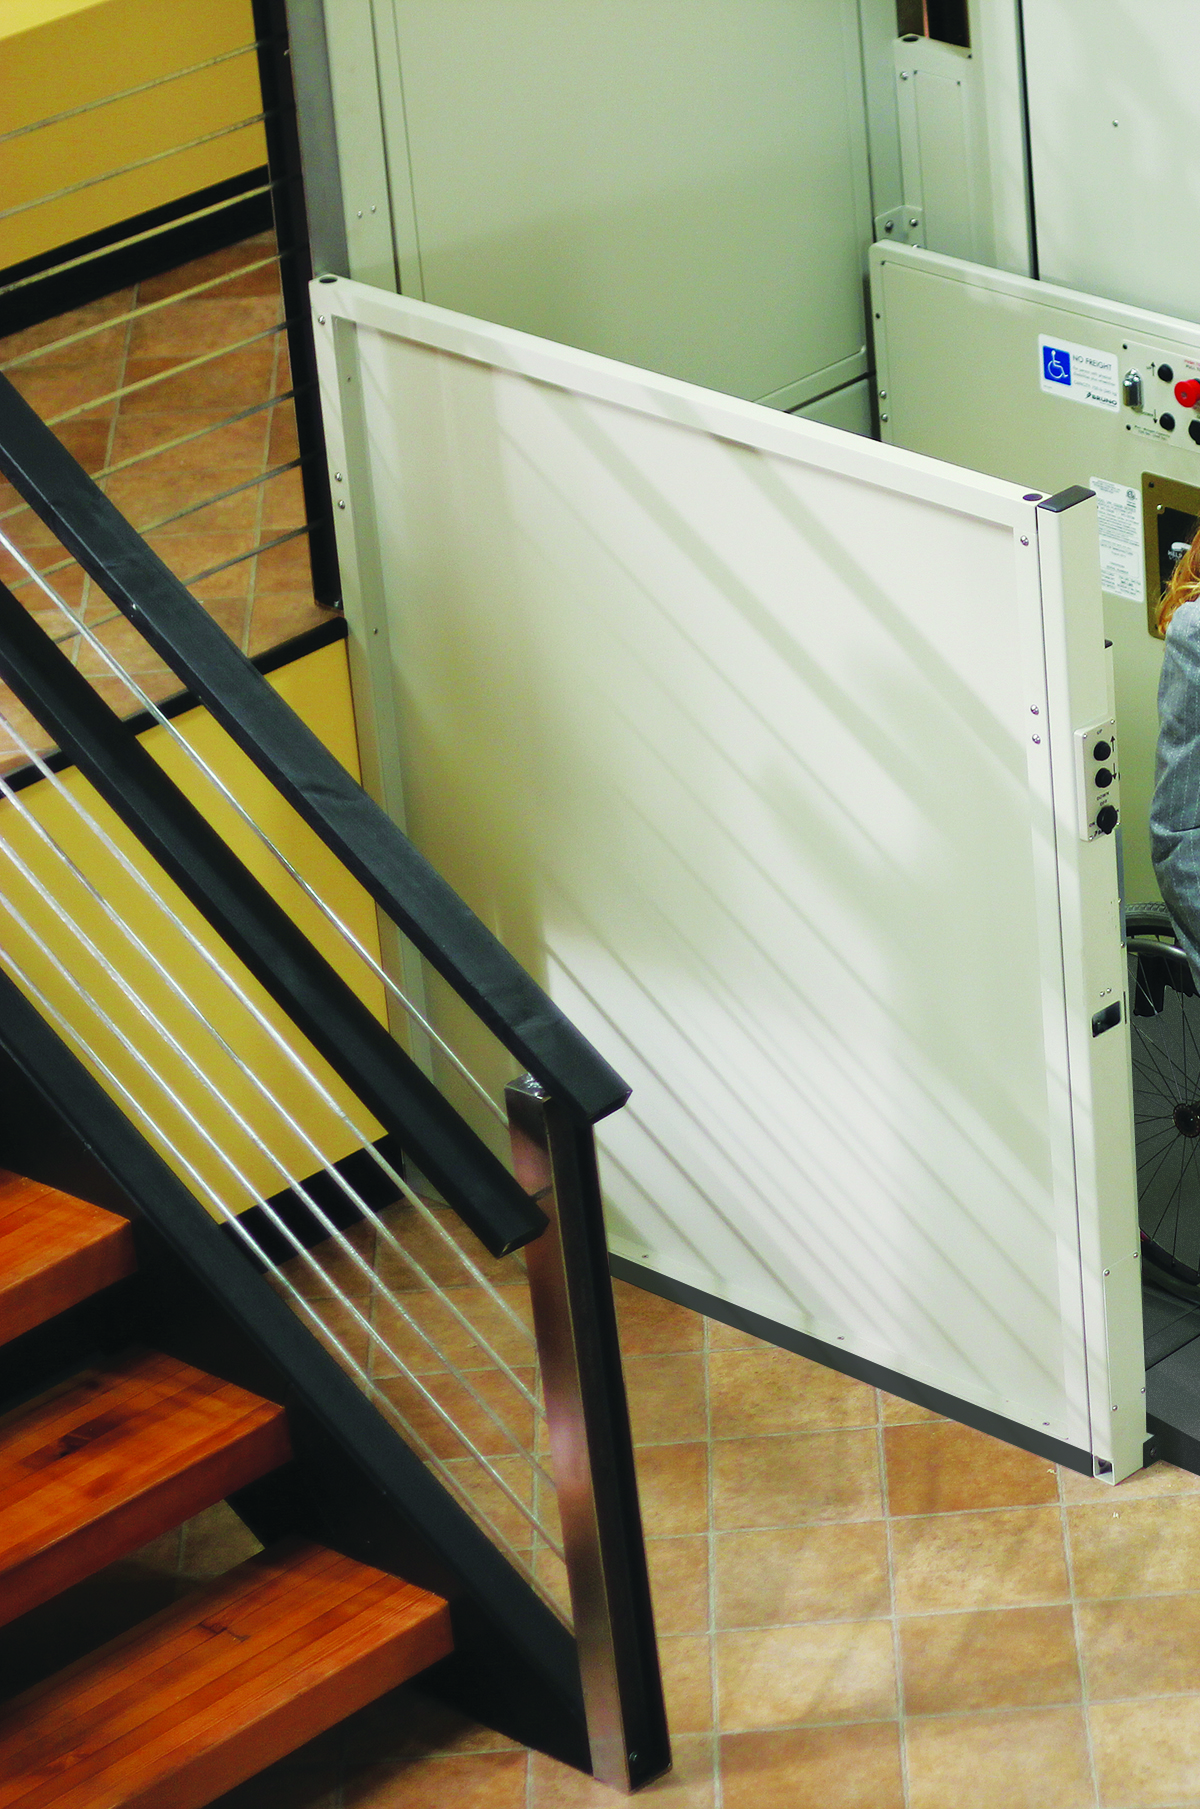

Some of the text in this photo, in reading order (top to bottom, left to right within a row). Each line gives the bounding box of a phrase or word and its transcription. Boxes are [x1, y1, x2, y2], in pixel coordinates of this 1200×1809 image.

[1072, 354, 1112, 371] NO FREIGHT
[1091, 394, 1118, 406] BRUNO
